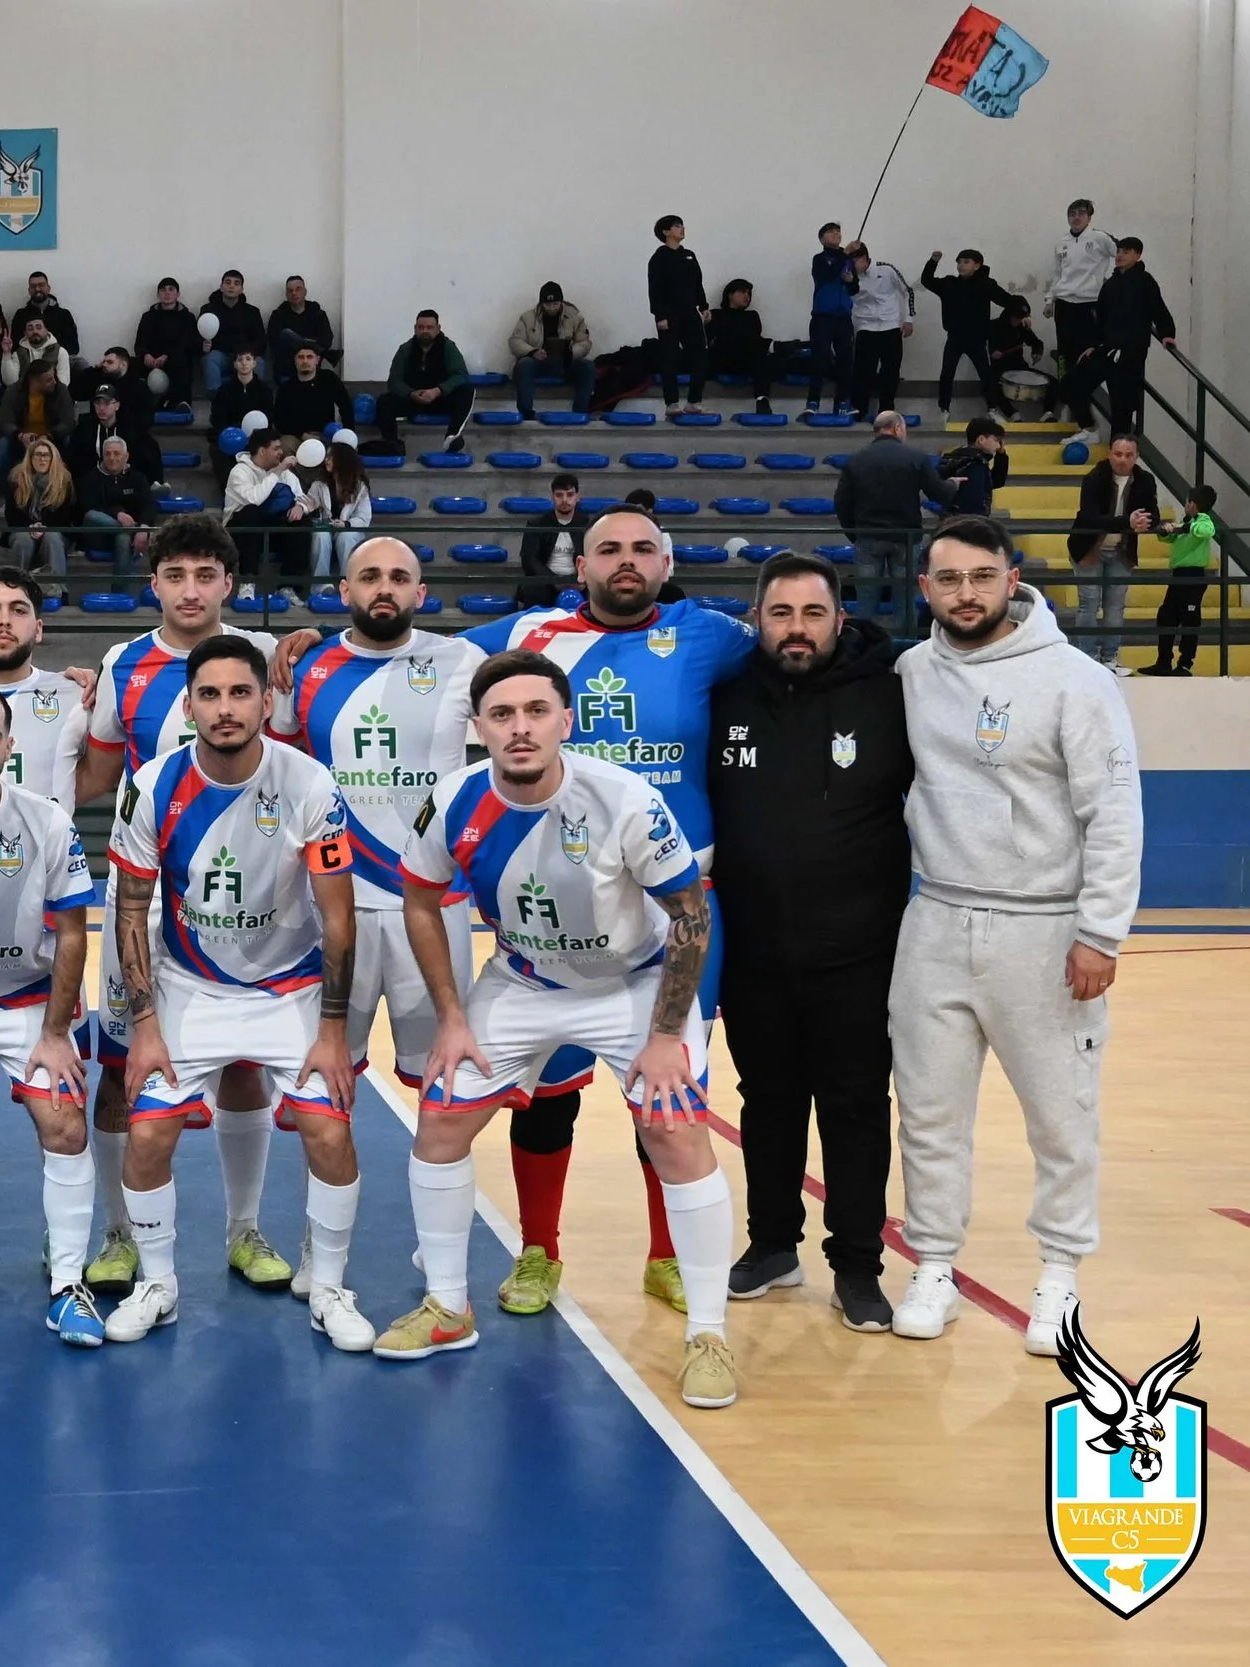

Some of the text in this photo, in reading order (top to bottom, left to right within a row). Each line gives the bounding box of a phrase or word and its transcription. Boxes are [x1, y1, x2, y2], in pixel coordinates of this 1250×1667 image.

[561, 738, 683, 763] ntefaro
[331, 765, 438, 787] iantefaro
[641, 770, 682, 785] TEAM
[349, 795, 427, 806] GREEN TEA
[320, 843, 342, 869] C
[654, 838, 679, 861] CED
[68, 859, 87, 873] CED
[180, 902, 277, 929] antefar
